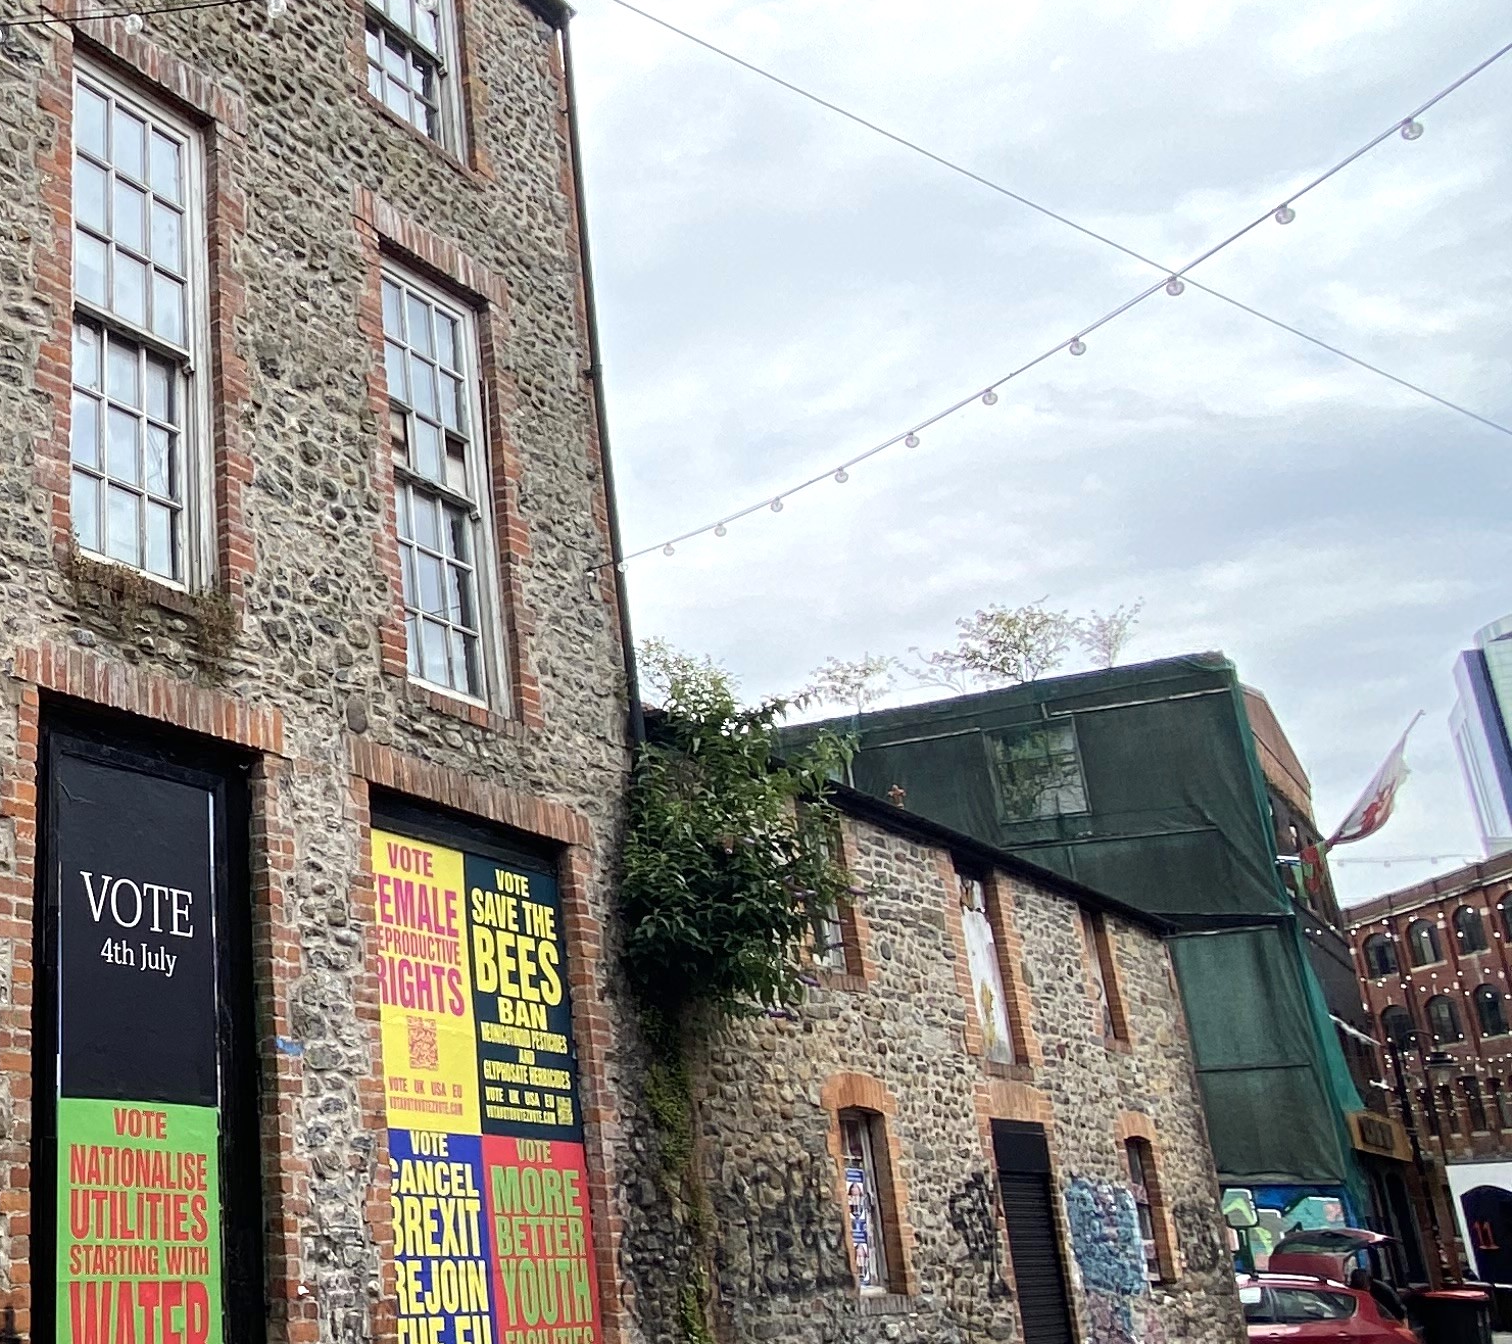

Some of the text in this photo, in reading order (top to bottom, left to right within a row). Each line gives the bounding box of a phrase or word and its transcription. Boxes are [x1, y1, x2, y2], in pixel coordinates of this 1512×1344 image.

[387, 841, 434, 878] VOTE
[80, 870, 194, 939] VOTE
[494, 869, 530, 898] VOTE
[375, 873, 459, 938] EMALE
[471, 887, 558, 941] SAVE THE
[100, 937, 178, 978] 4th July
[376, 925, 462, 967] EPRODUCTIVE
[472, 924, 563, 1006] BEES
[497, 996, 549, 1031] BAN
[485, 1085, 504, 1103] VOTE
[113, 1107, 167, 1140] VOTE
[409, 1129, 450, 1157] VOTE
[69, 1143, 208, 1192] NATIONALISE
[516, 1137, 553, 1164] VOTE
[490, 1164, 583, 1217] MORE
[70, 1189, 209, 1242] UTILITIES
[494, 1215, 587, 1257] BETTER
[69, 1244, 209, 1276] STARTING WITH
[499, 1257, 593, 1327] YOUTH
